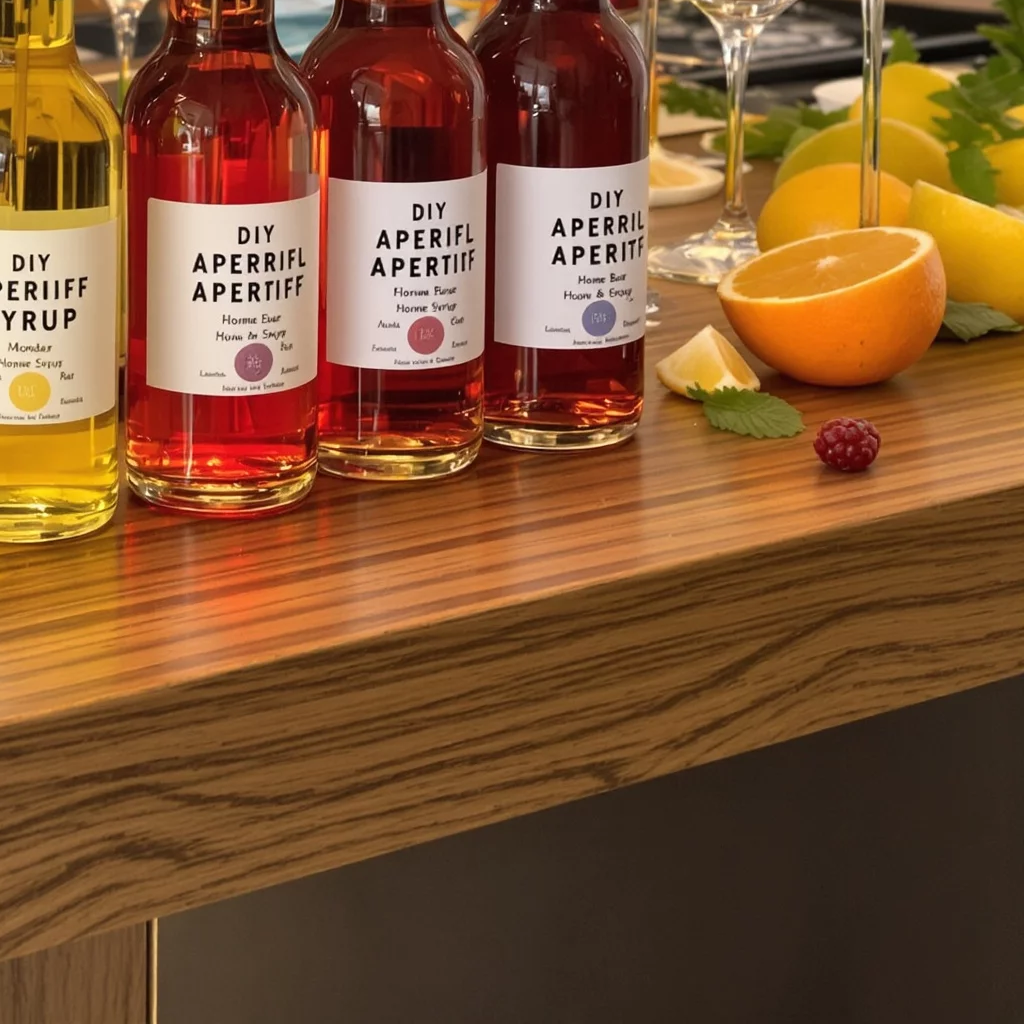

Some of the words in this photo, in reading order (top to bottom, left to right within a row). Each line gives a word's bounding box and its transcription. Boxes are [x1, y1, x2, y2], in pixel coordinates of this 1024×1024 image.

[412, 202, 446, 222] DIY
[590, 189, 624, 210] DIY
[238, 224, 274, 245] DIY
[376, 223, 474, 250] APERIFL
[551, 210, 644, 238] APERRIL
[12, 254, 51, 272] DIY
[192, 248, 306, 274] APERRIFL
[551, 236, 644, 266] APERITF
[192, 274, 304, 302] APERTIFF
